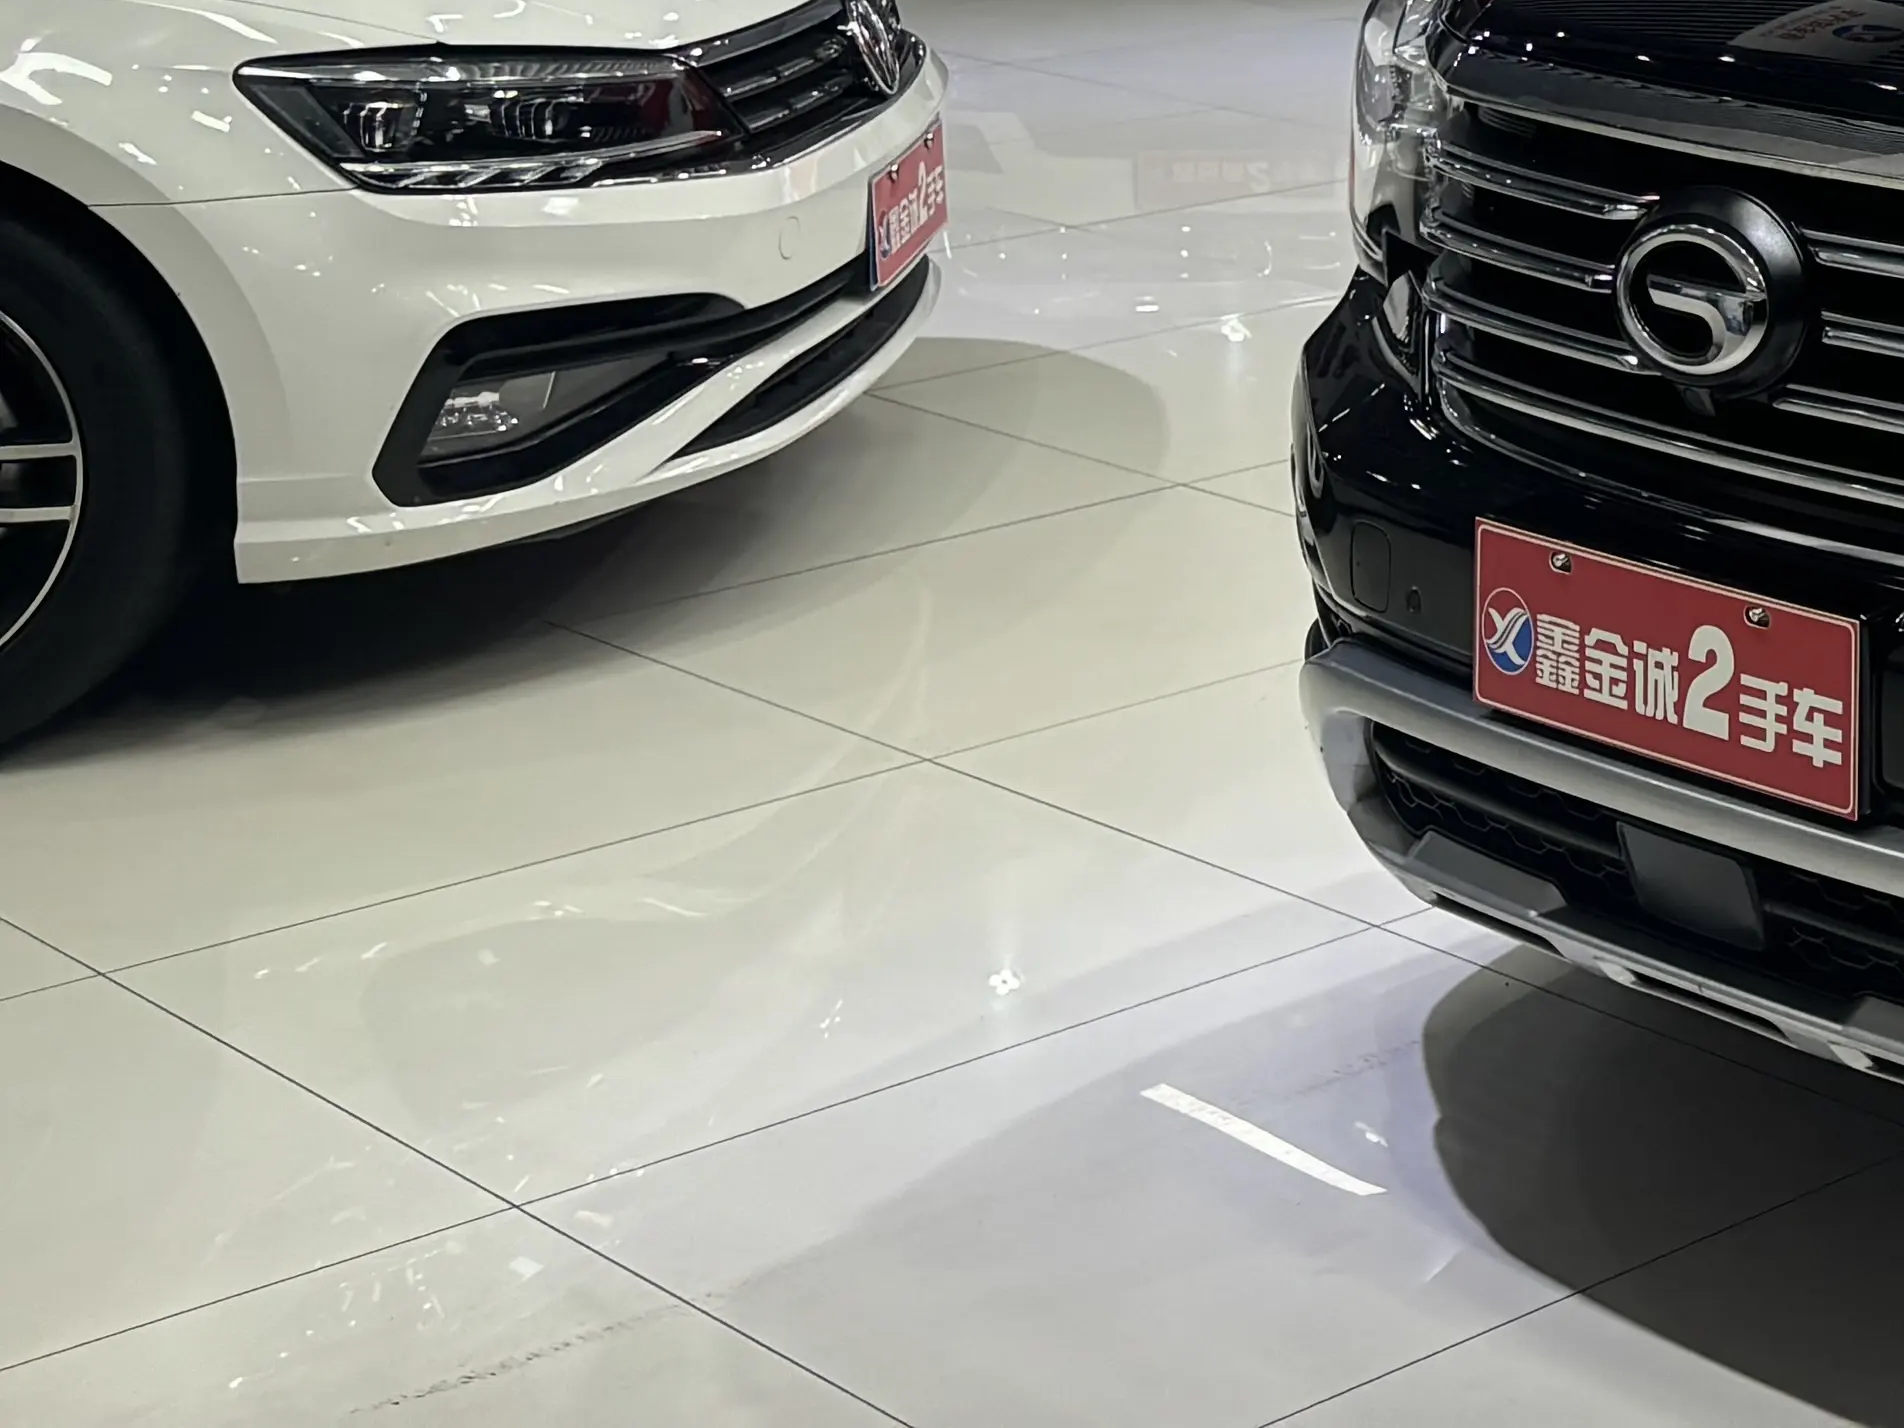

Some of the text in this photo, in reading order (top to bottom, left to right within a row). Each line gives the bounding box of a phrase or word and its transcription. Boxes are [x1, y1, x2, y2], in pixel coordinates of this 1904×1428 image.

[1535, 612, 1844, 768] 鑫金诚2手车
